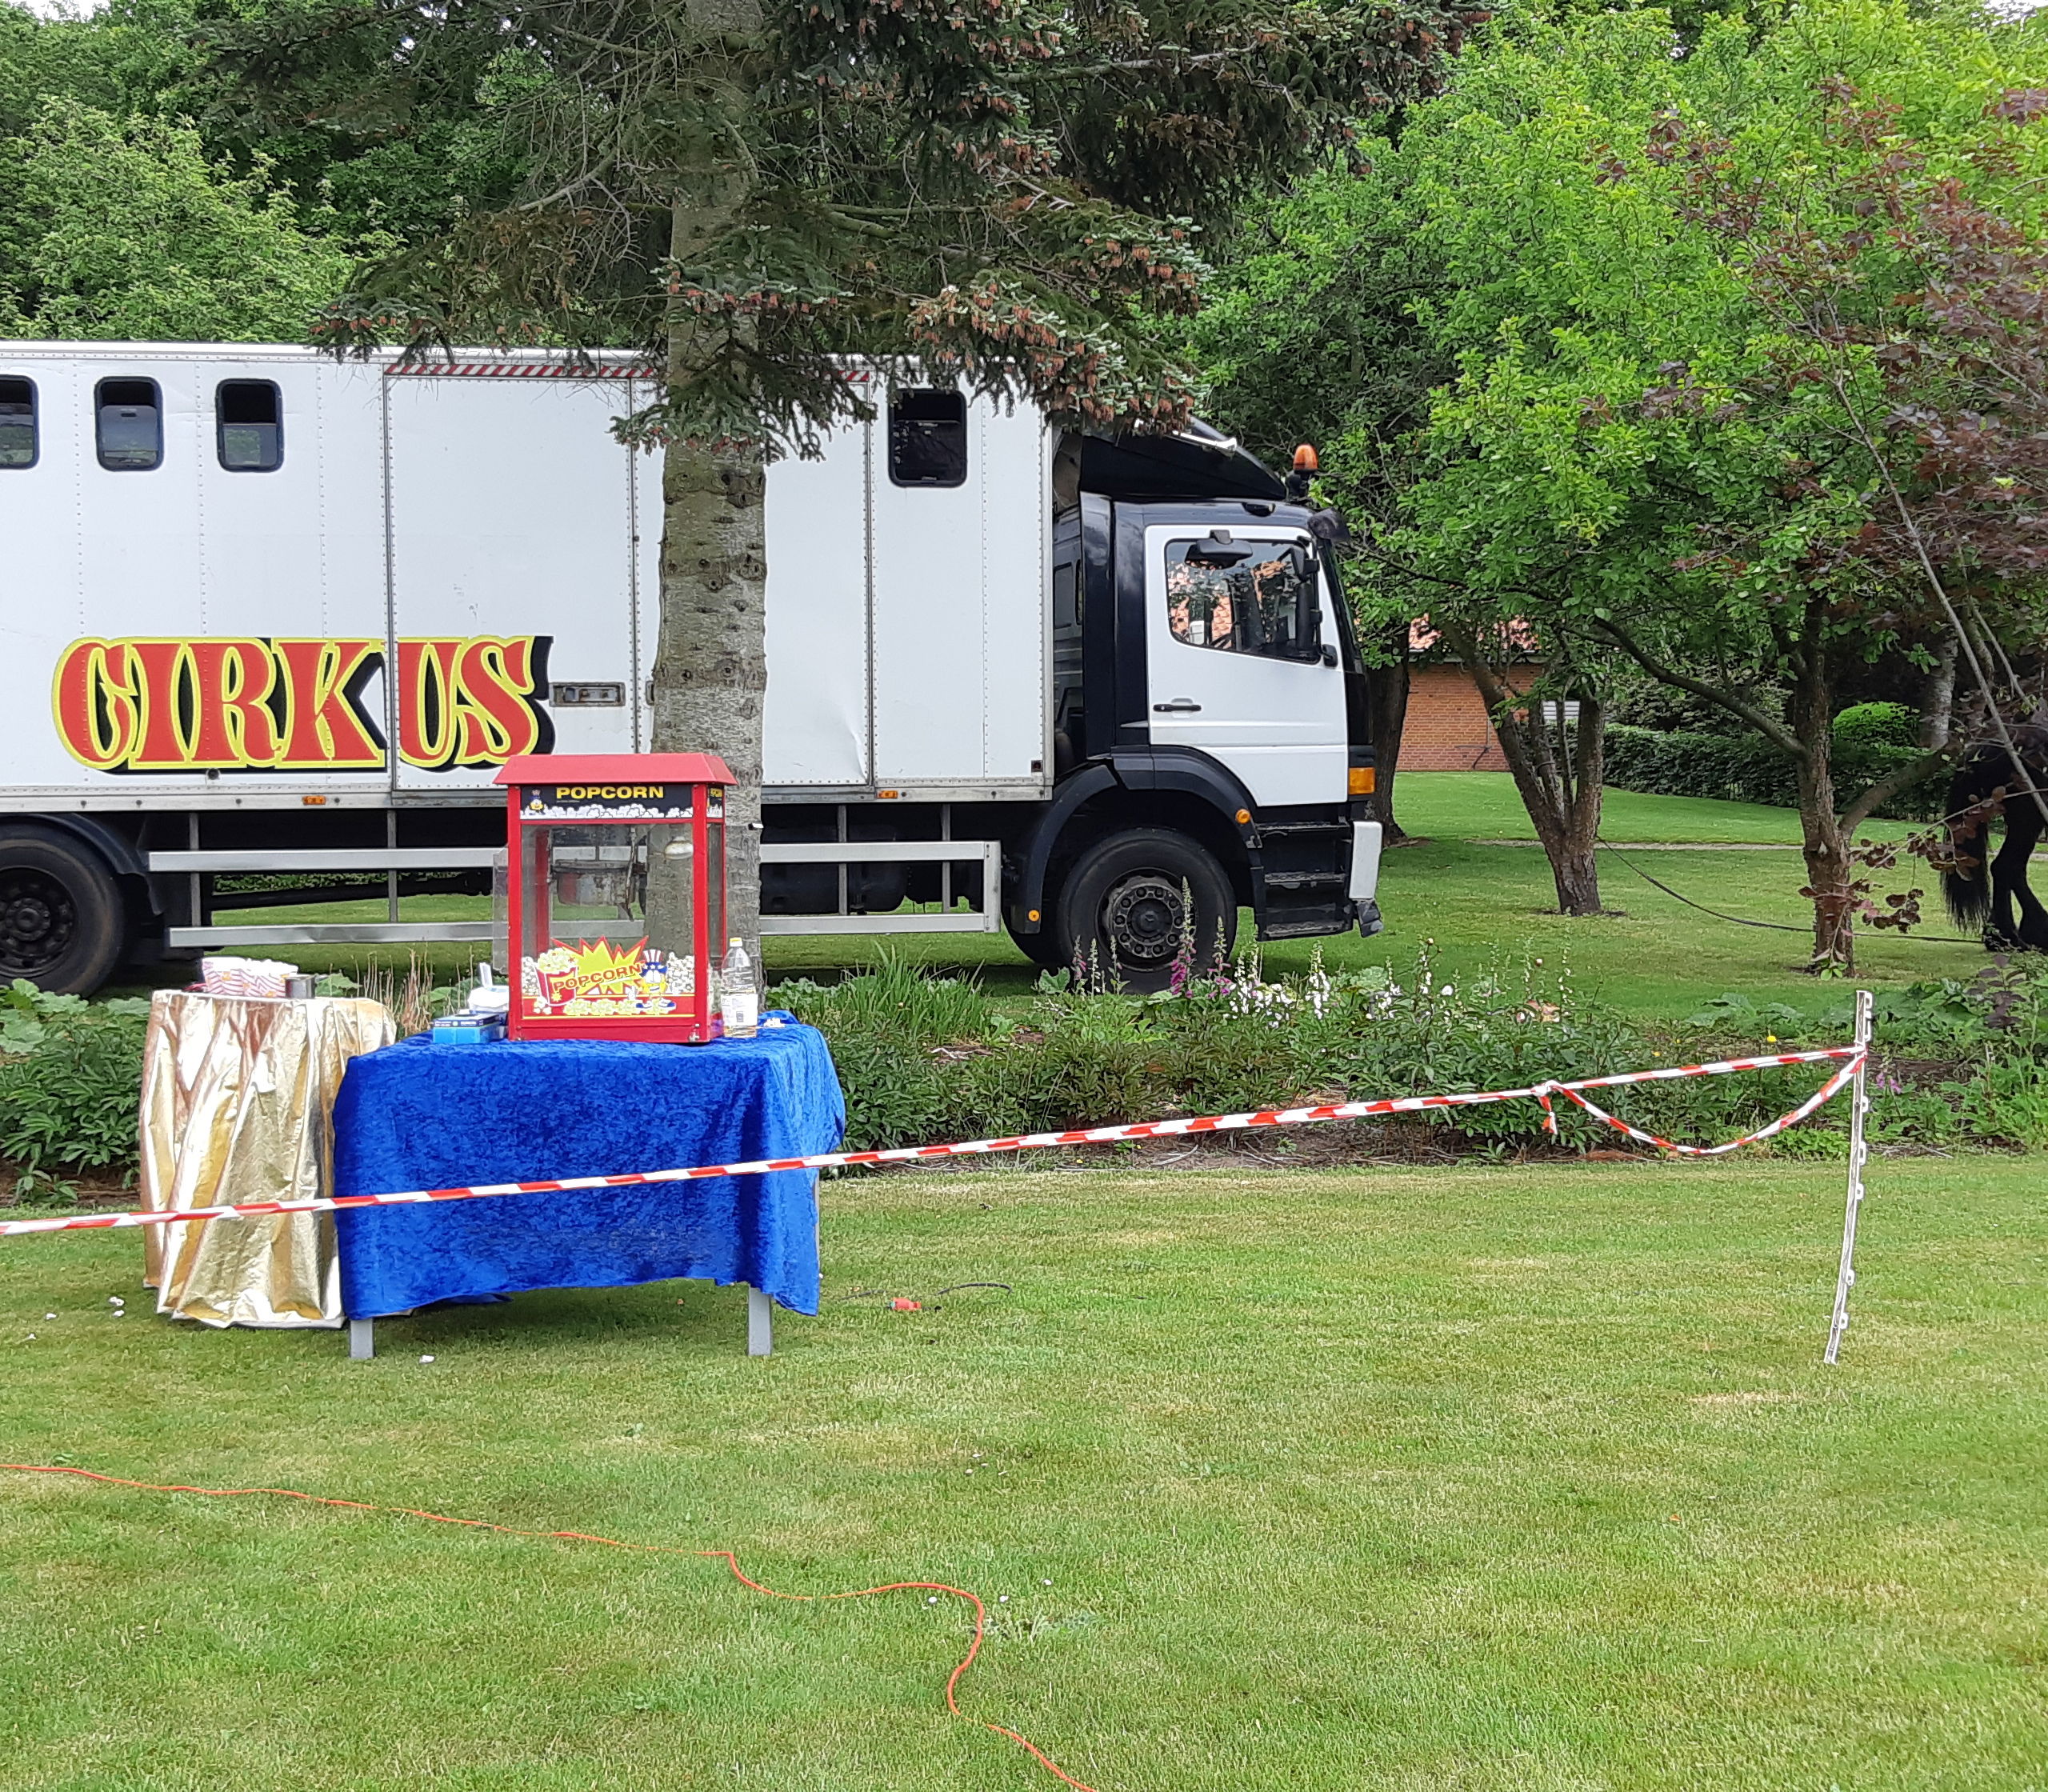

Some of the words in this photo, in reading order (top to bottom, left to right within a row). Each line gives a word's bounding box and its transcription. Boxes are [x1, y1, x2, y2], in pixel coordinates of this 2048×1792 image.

[53, 636, 552, 773] CIRKUS
[556, 786, 664, 799] POPCORN
[552, 963, 644, 992] POPCORN
